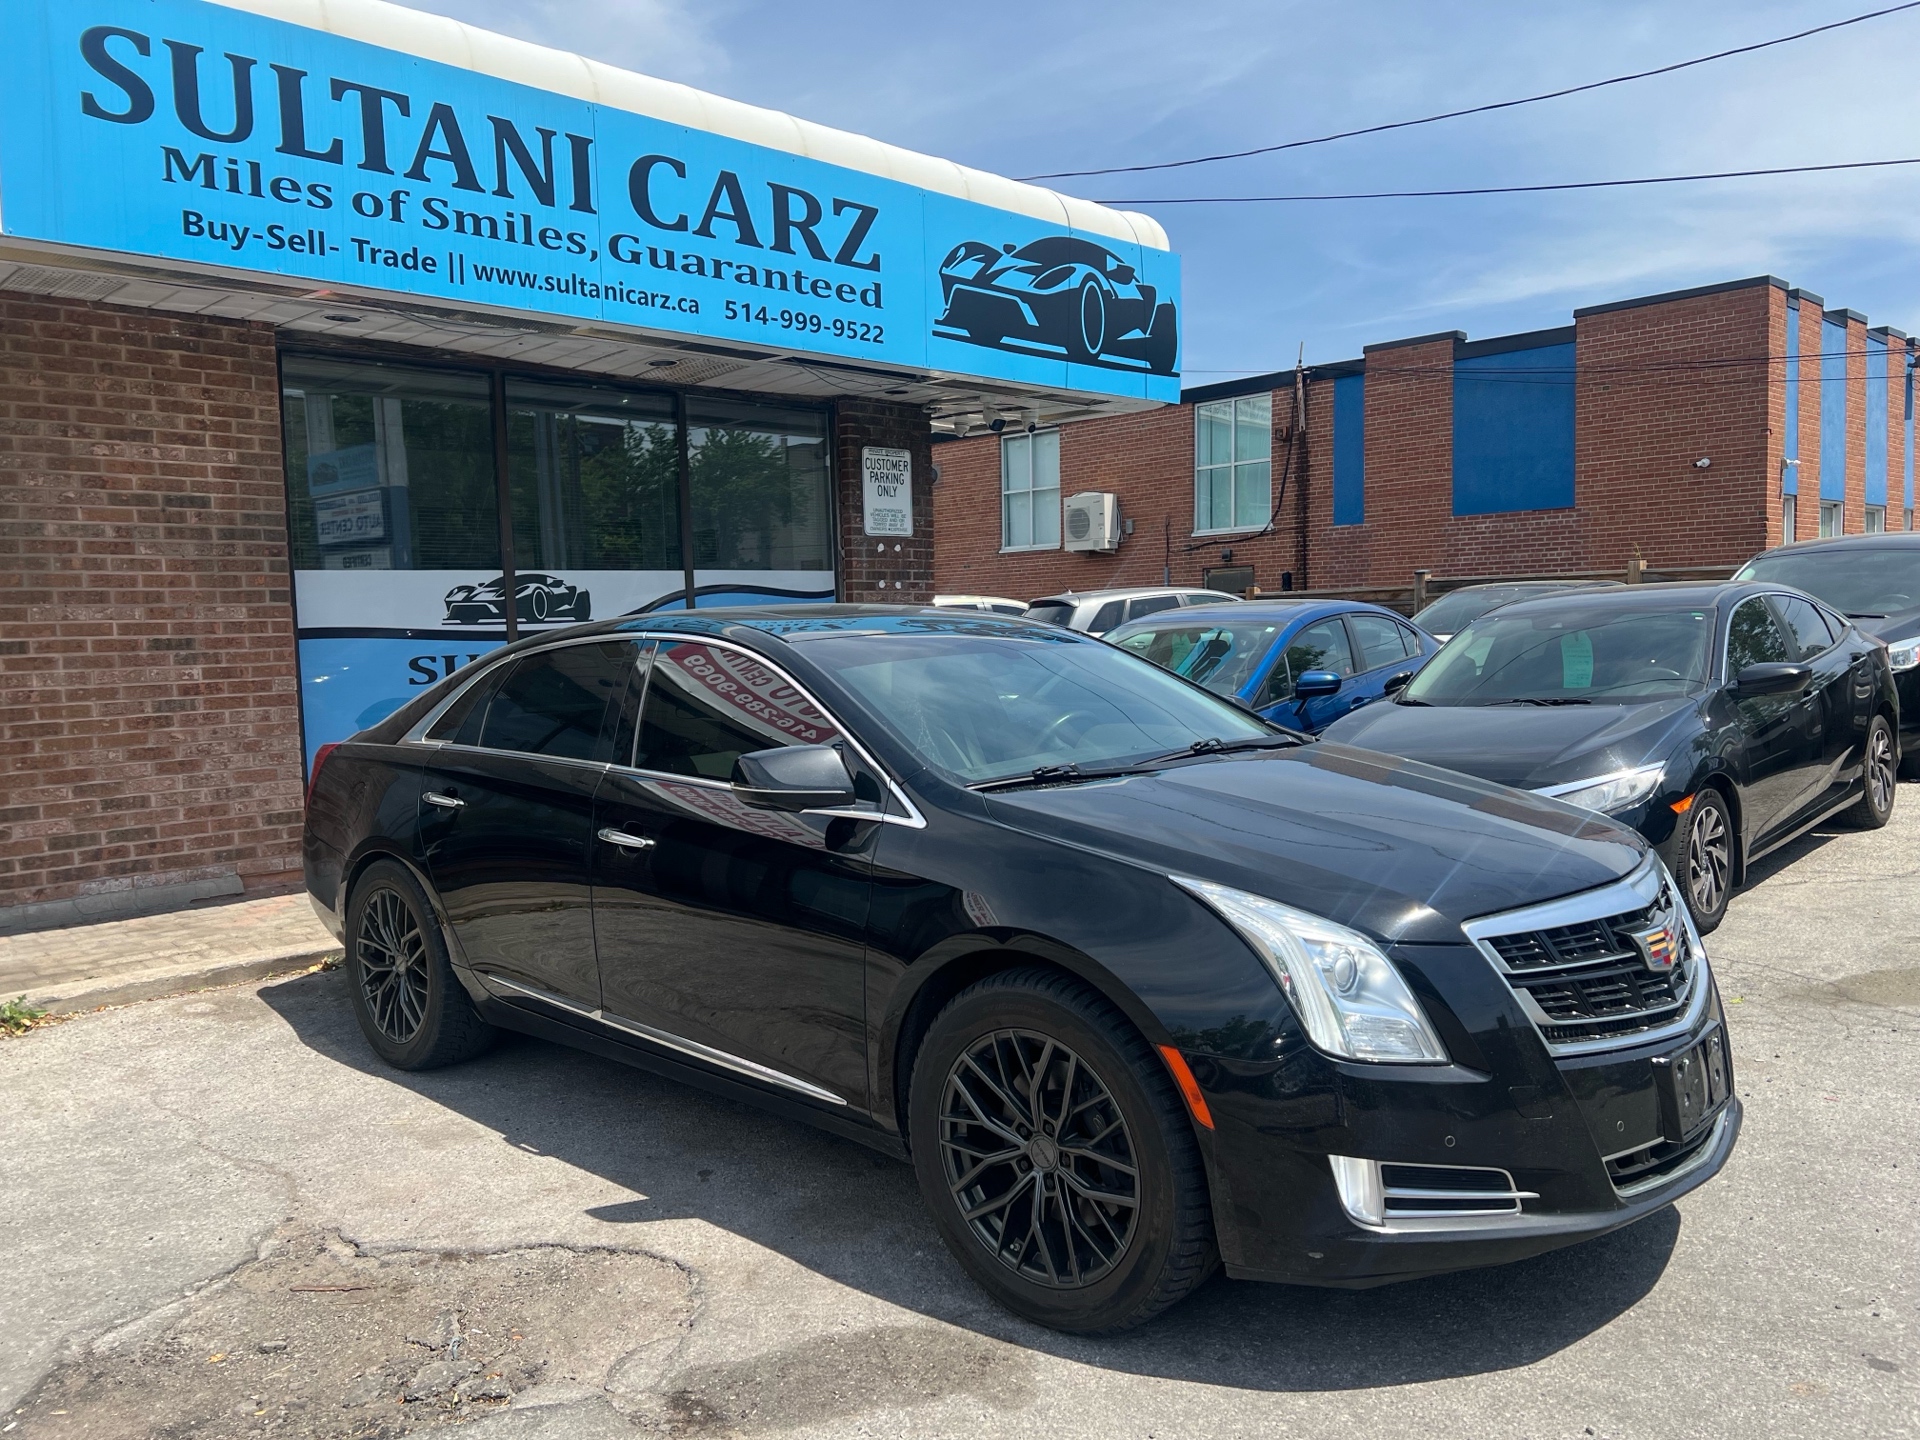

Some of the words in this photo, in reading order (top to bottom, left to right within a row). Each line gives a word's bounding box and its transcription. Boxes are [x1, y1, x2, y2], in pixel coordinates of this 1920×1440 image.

[81, 26, 598, 215] SULTANI
[628, 154, 881, 273] CARZ
[160, 145, 333, 210] Miles
[352, 189, 411, 224] of
[422, 197, 599, 264] Smiles,
[608, 234, 884, 310] Guaranteed
[350, 237, 437, 275] Trade
[473, 264, 700, 316] www.sultanicarz.ca
[725, 299, 885, 345] 514-999-9522
[865, 457, 909, 472] CUSTOMER
[869, 472, 905, 485] PARKING
[877, 485, 898, 497] ONLY
